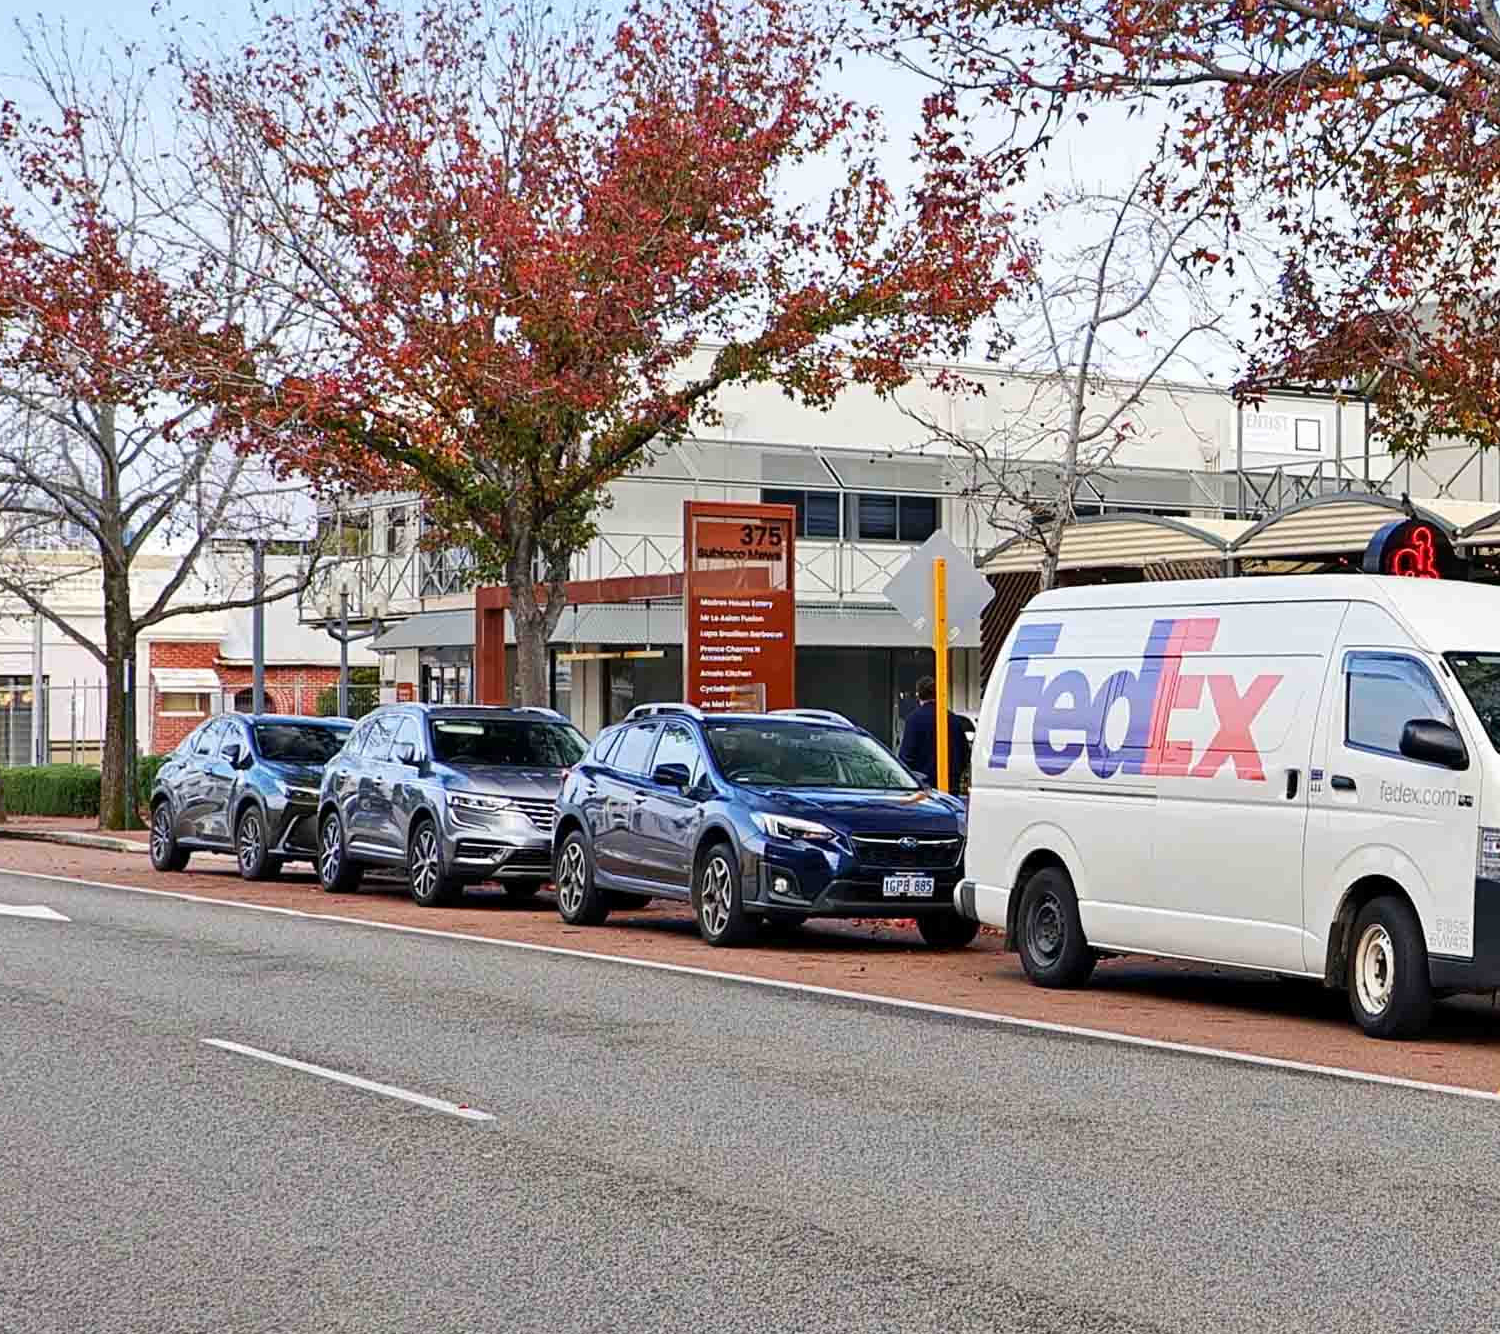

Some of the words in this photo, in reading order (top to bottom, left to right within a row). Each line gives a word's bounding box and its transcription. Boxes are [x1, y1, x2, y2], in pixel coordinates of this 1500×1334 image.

[741, 524, 782, 546] 375
[697, 546, 746, 559] Subiaco
[741, 614, 764, 622] Fusion
[987, 617, 1285, 781] FedEx
[1380, 780, 1458, 806] fedex.com
